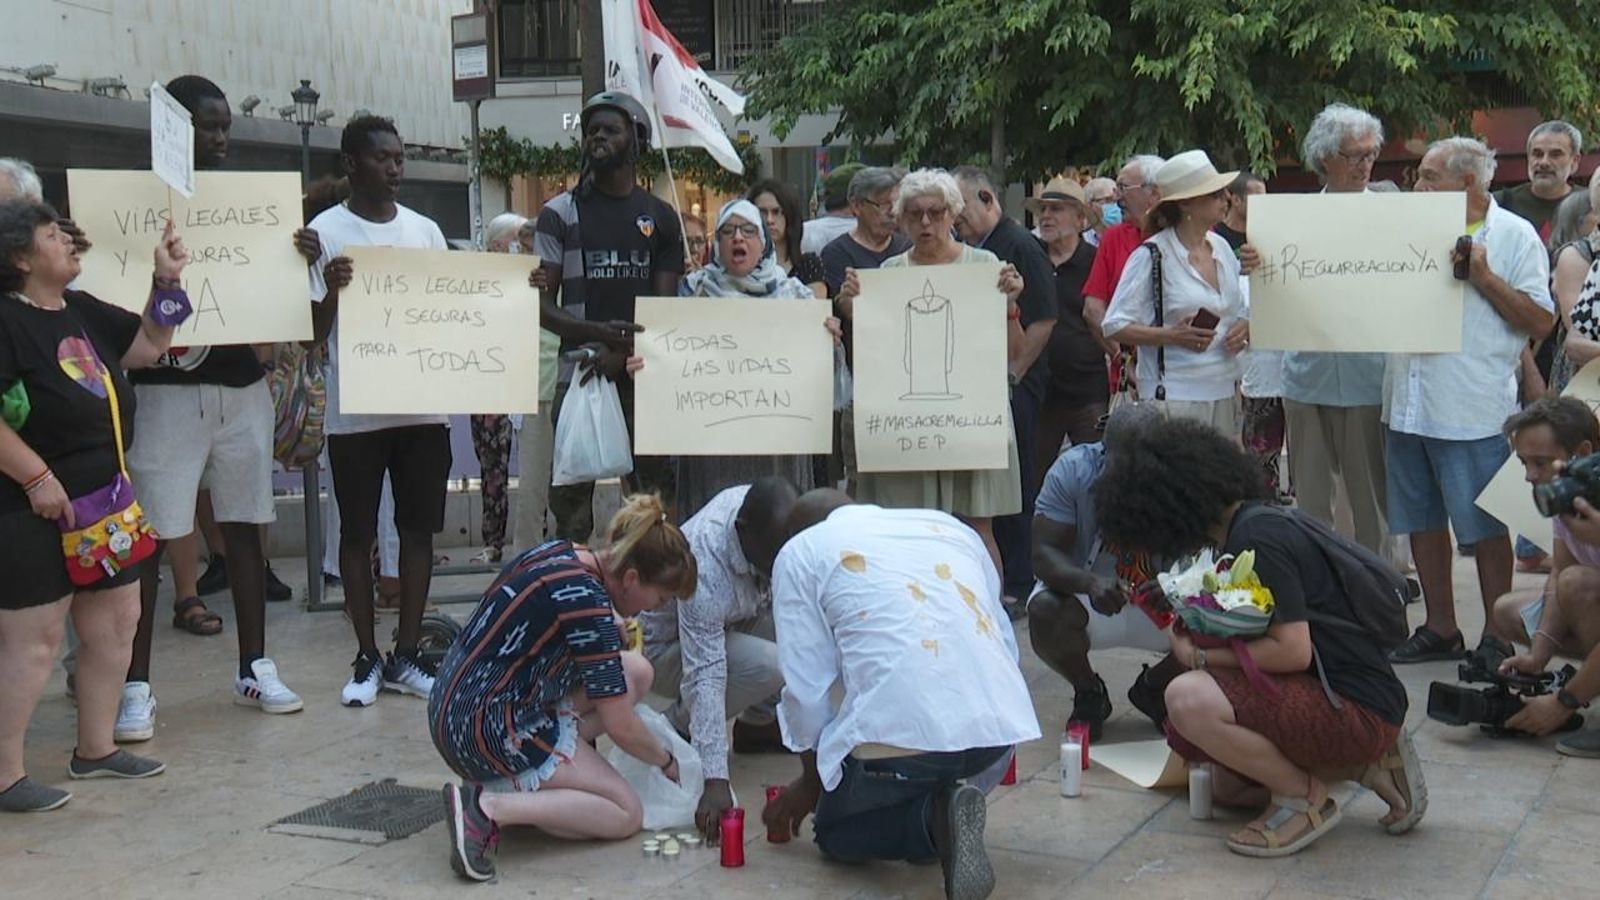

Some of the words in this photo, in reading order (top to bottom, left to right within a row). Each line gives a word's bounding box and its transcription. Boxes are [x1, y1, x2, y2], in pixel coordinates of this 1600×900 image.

[186, 204, 280, 227] LEGALES
[113, 249, 129, 277] Y
[425, 276, 503, 298] LEGALES
[383, 306, 393, 328] Y
[404, 307, 486, 328] SEGURAS
[654, 327, 738, 353] TODAS
[352, 341, 398, 359] PARA
[406, 346, 506, 373] TODAS
[681, 359, 721, 378] LAS
[727, 357, 793, 376] VIDAS
[675, 388, 791, 412] IMPORTAN
